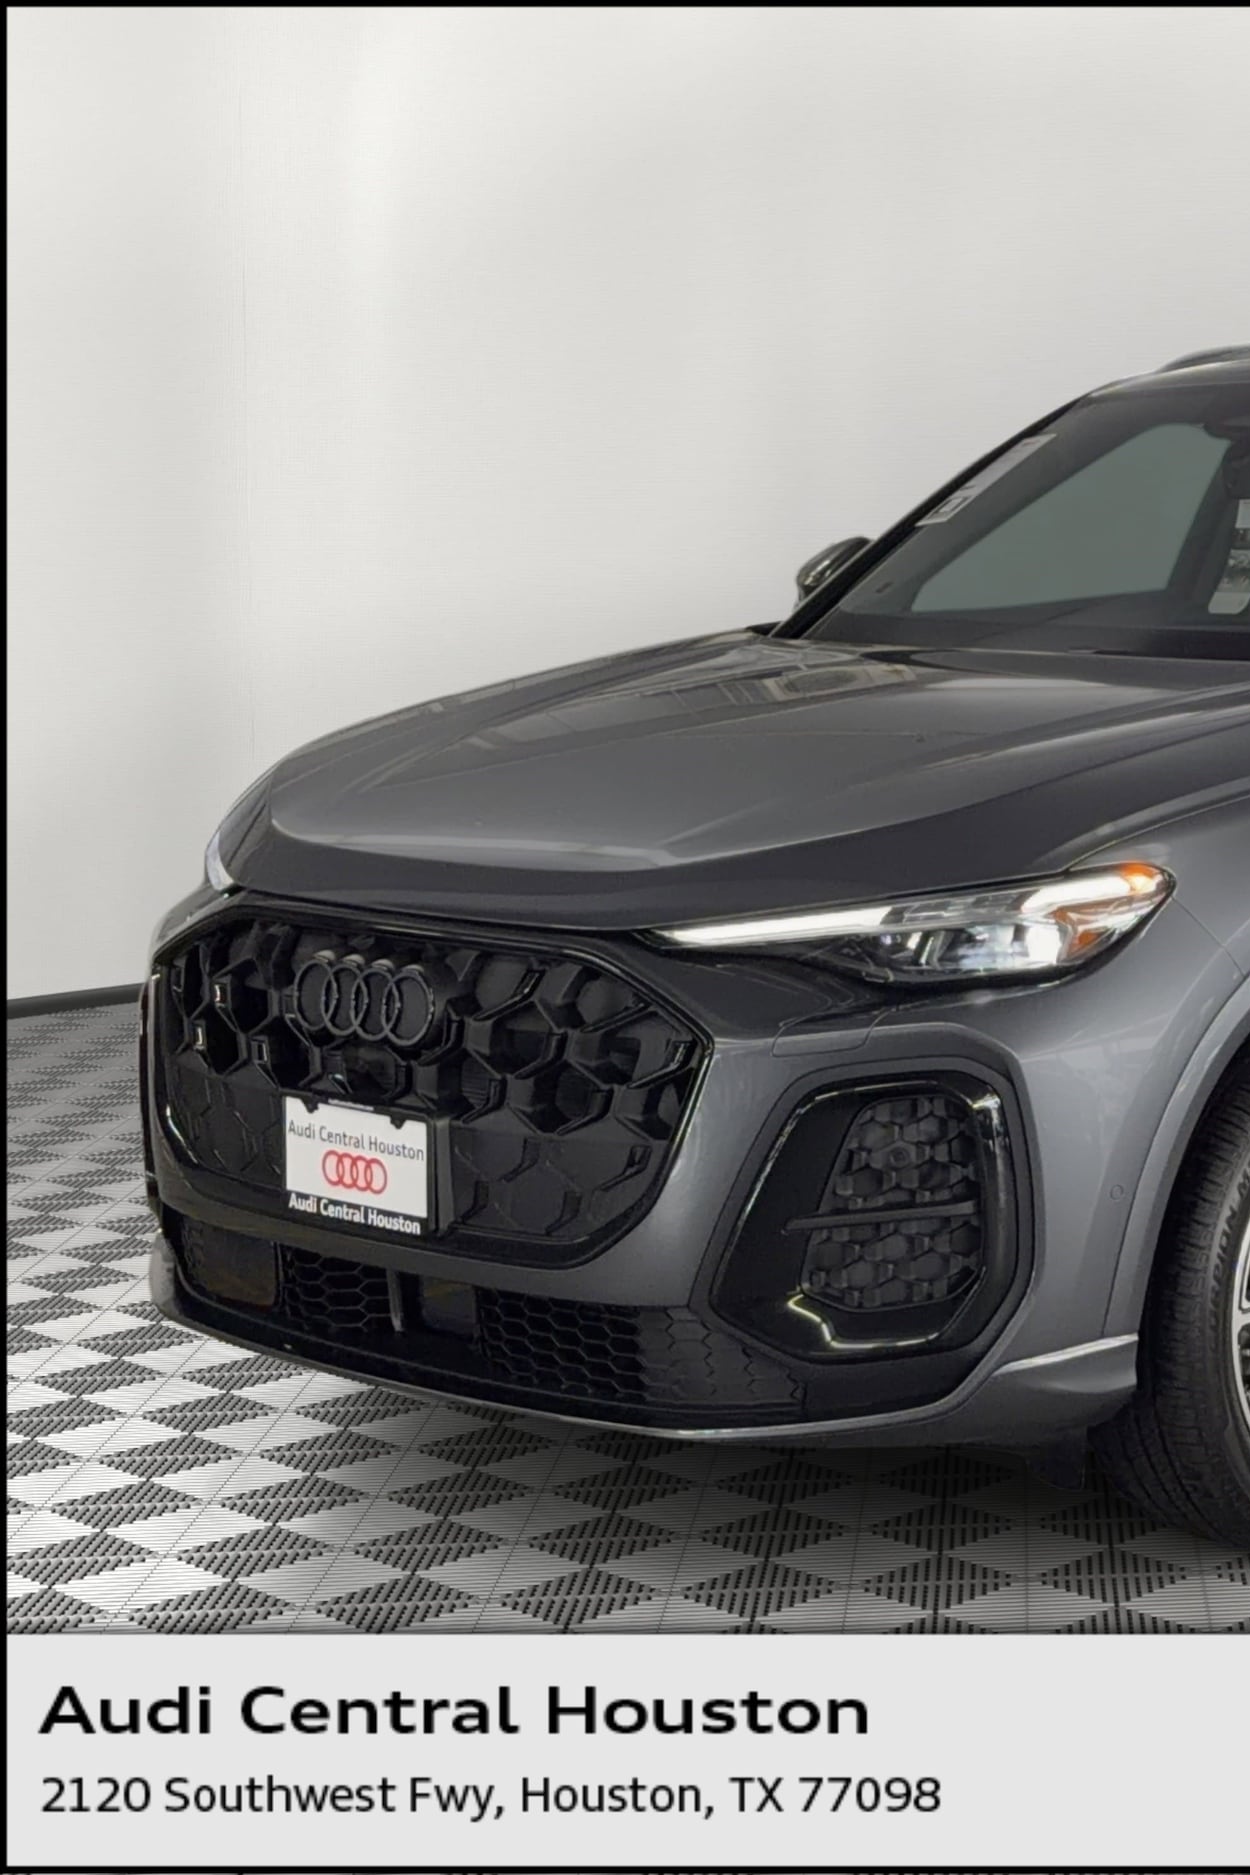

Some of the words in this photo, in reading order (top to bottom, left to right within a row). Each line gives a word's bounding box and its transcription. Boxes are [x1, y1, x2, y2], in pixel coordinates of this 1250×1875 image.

[288, 1120, 315, 1139] Audi
[319, 1126, 365, 1150] Central
[369, 1136, 425, 1161] Houston
[288, 1193, 317, 1214] Audi
[320, 1199, 365, 1223] Central
[368, 1209, 421, 1236] Houston
